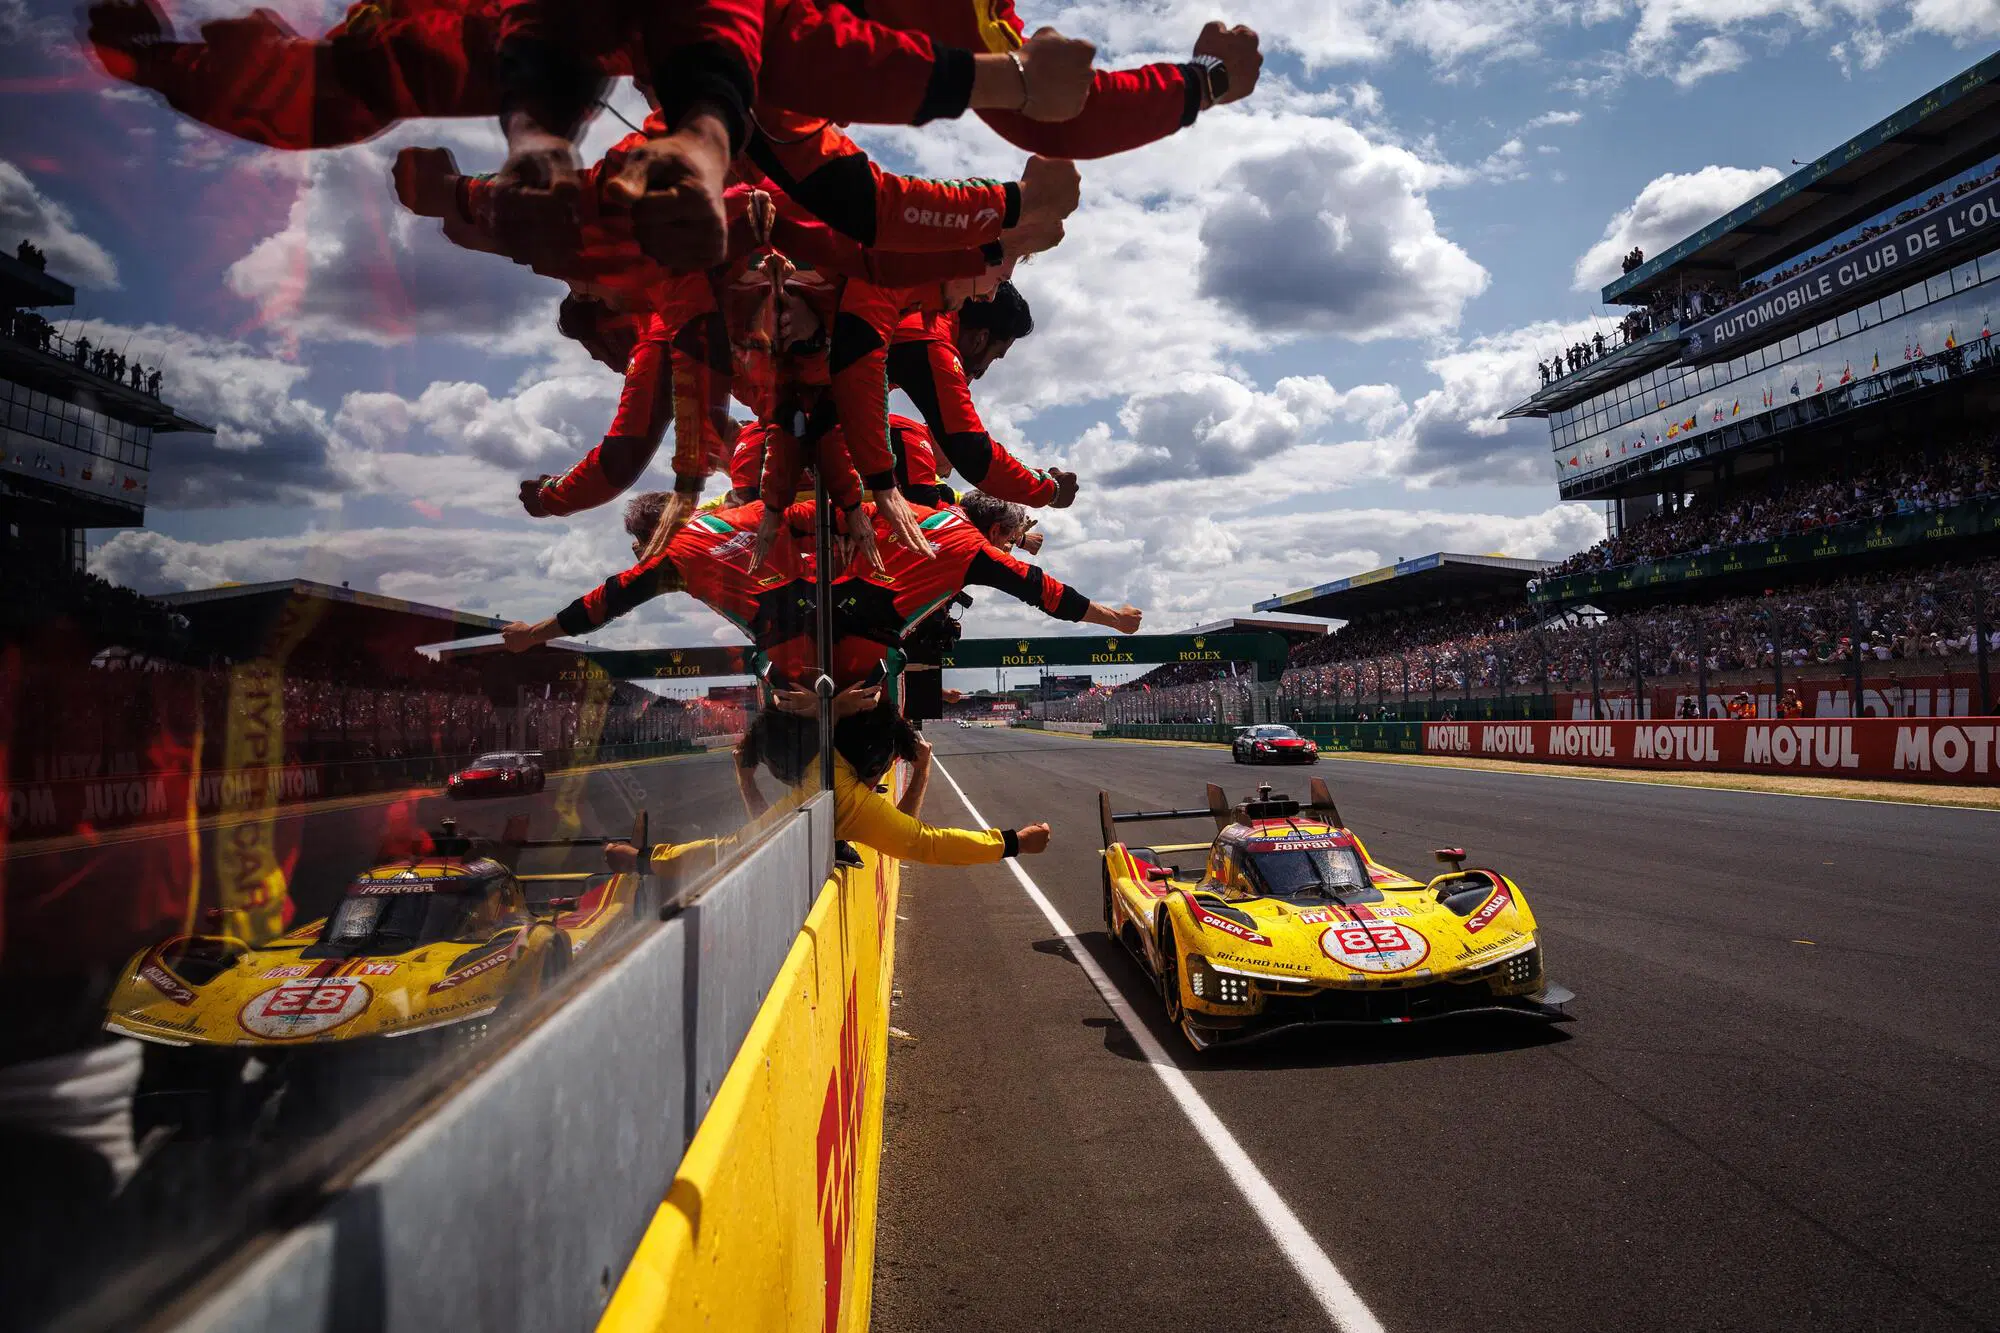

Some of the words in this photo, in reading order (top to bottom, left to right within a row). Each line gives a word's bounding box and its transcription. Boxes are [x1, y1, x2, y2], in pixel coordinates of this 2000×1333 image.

[903, 207, 969, 230] ORLEN
[1714, 274, 1833, 344] AUTOMOBILE
[1838, 244, 1899, 286] CLUB
[1905, 224, 1940, 257] DE
[1926, 526, 1956, 538] ROLEX
[1813, 545, 1838, 557] ROLEX
[1866, 536, 1894, 549] ROLEX
[1723, 562, 1743, 572] ROLEX
[1766, 554, 1789, 565] ROLEX
[1002, 655, 1045, 665] ROLEX
[1092, 653, 1134, 664] ROLEX
[1180, 651, 1221, 661] ROLEX
[1427, 725, 1471, 751] MOTUL
[1482, 725, 1535, 753] MOTUL
[1549, 725, 1615, 757] MOTUL
[1633, 725, 1719, 761] MOTUL
[1744, 725, 1859, 768] MOTUL
[1273, 840, 1337, 851] Ferrari
[1481, 894, 1508, 917] ORLEN
[1203, 916, 1243, 936] ORLEN
[1303, 912, 1328, 924] HY
[1341, 930, 1404, 950] 83
[1216, 951, 1270, 967] RICHARD
[1273, 962, 1312, 972] MILLE
